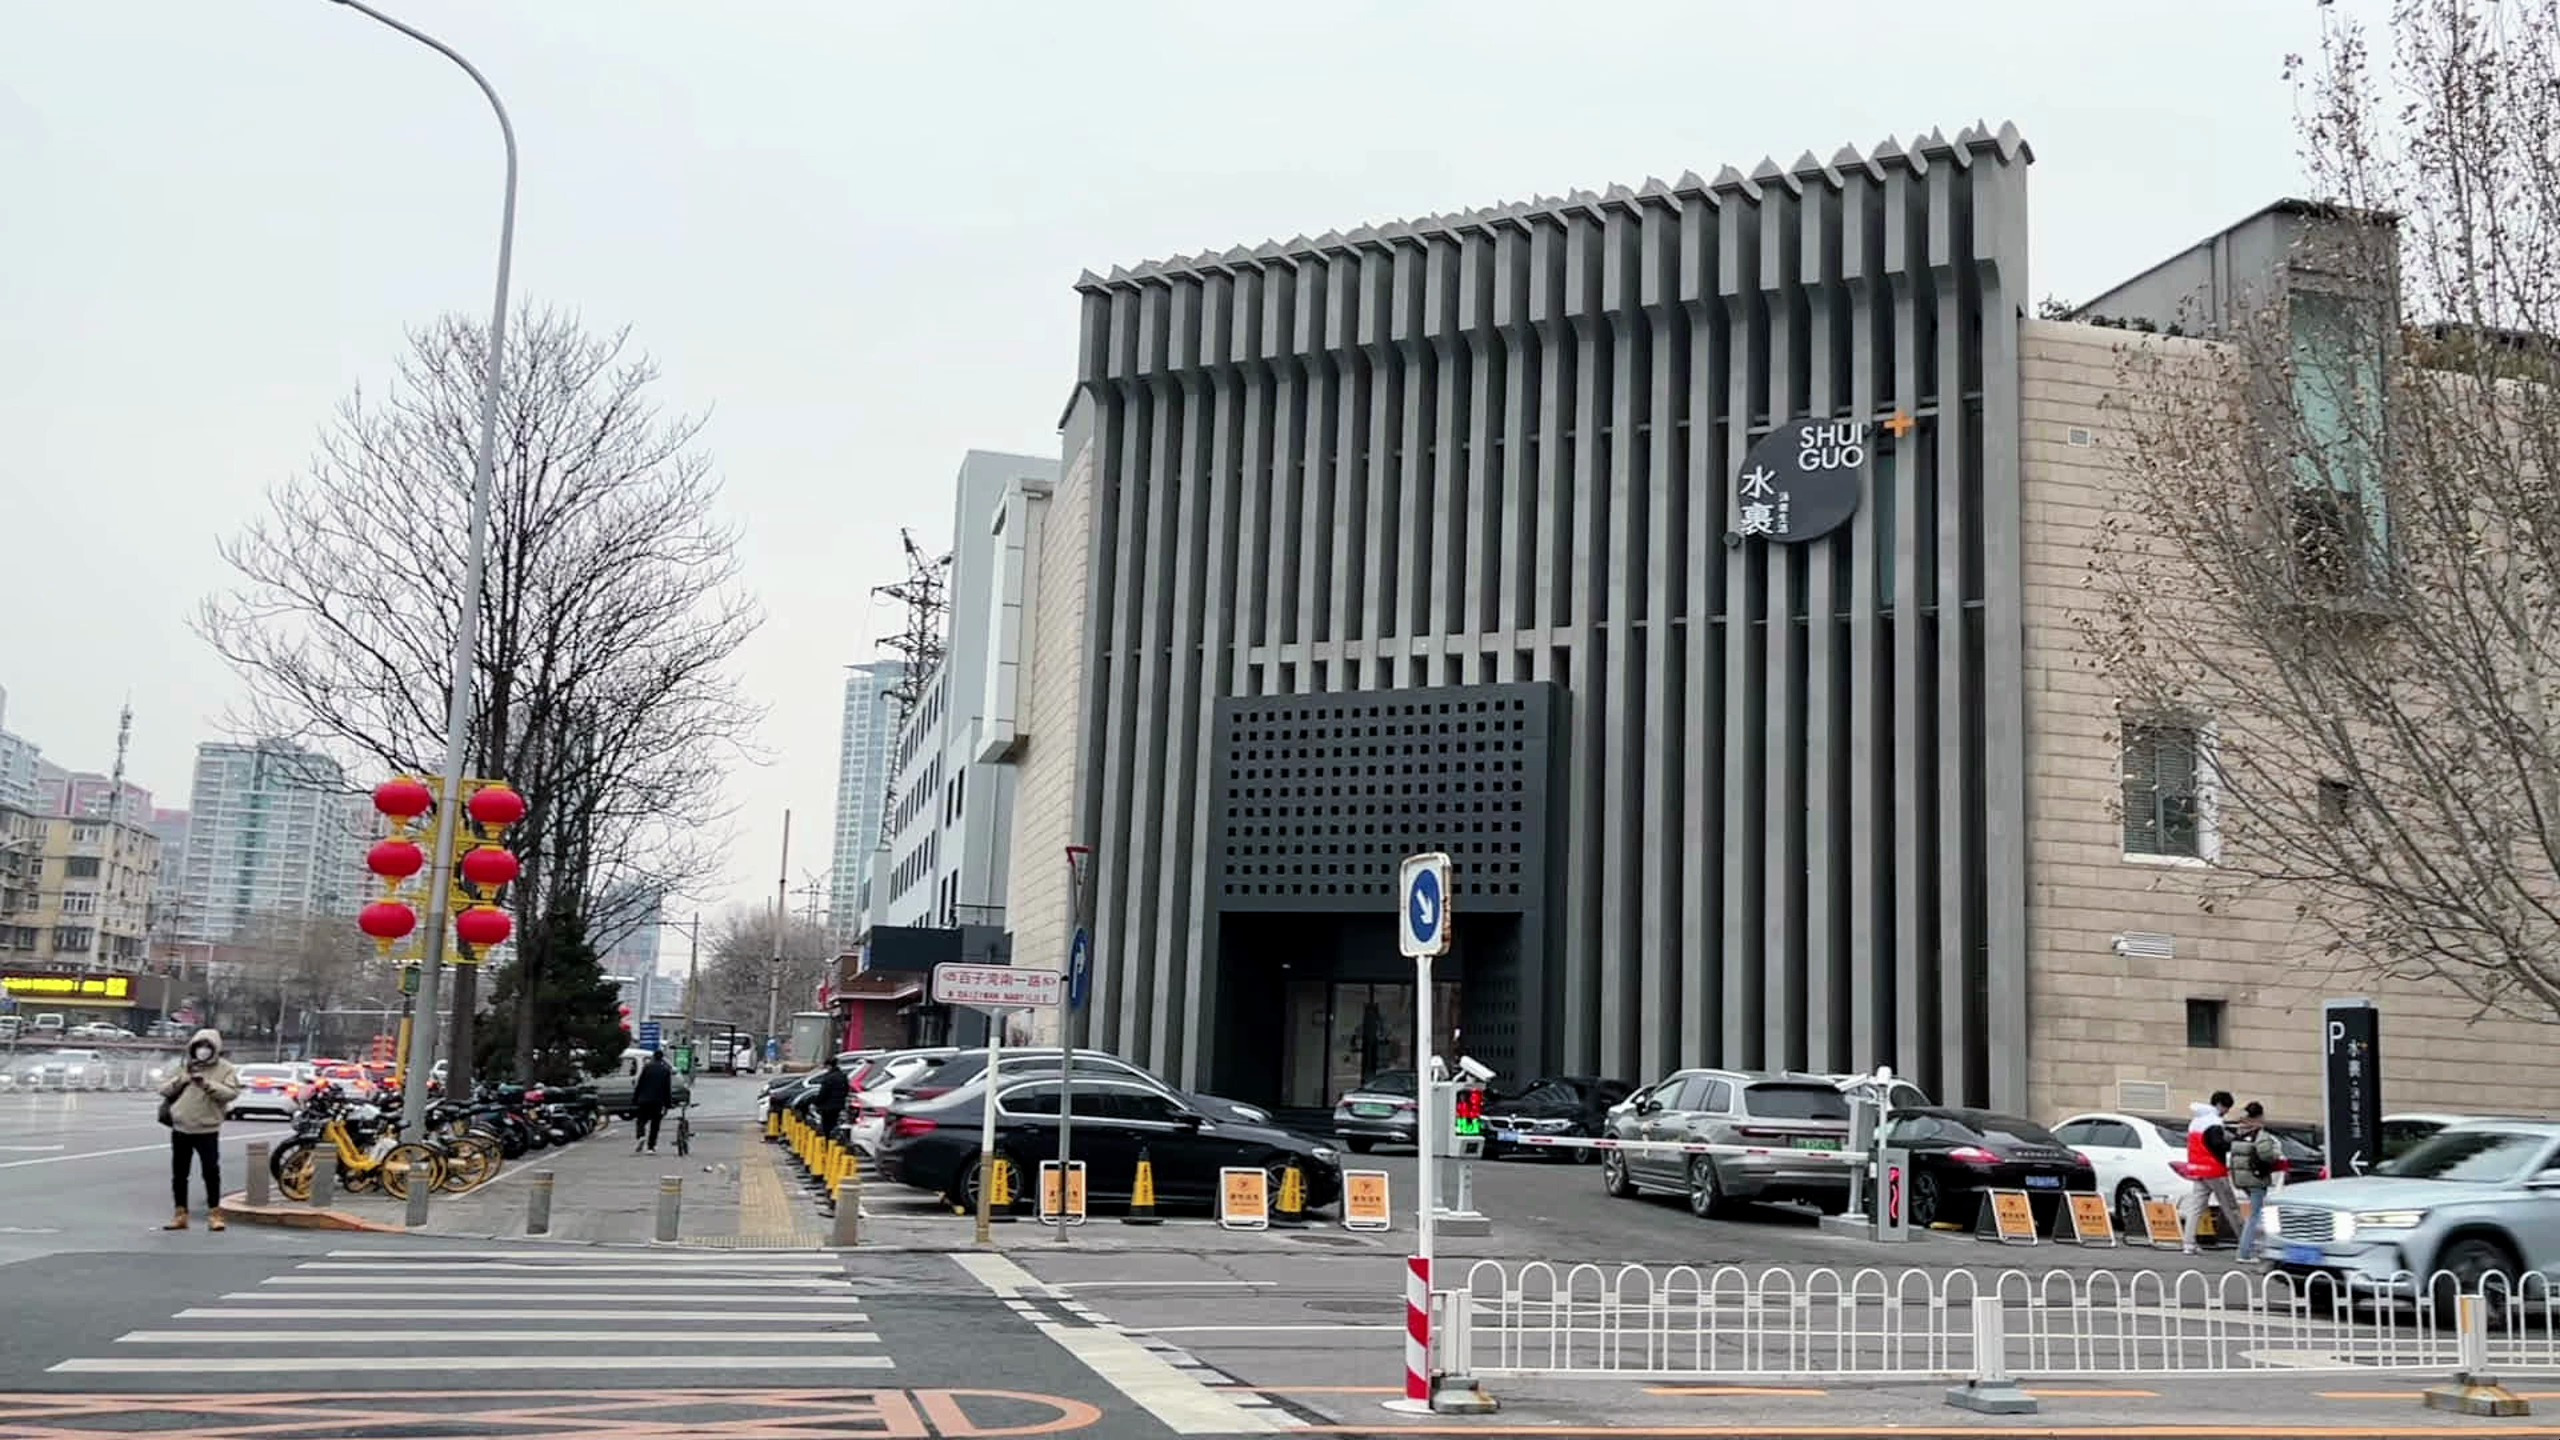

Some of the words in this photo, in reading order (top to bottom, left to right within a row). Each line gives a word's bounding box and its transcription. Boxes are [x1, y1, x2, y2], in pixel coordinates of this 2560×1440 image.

[1800, 422, 1863, 449] SHUI
[1798, 445, 1864, 471] GUO
[2328, 1021, 2345, 1055] P
